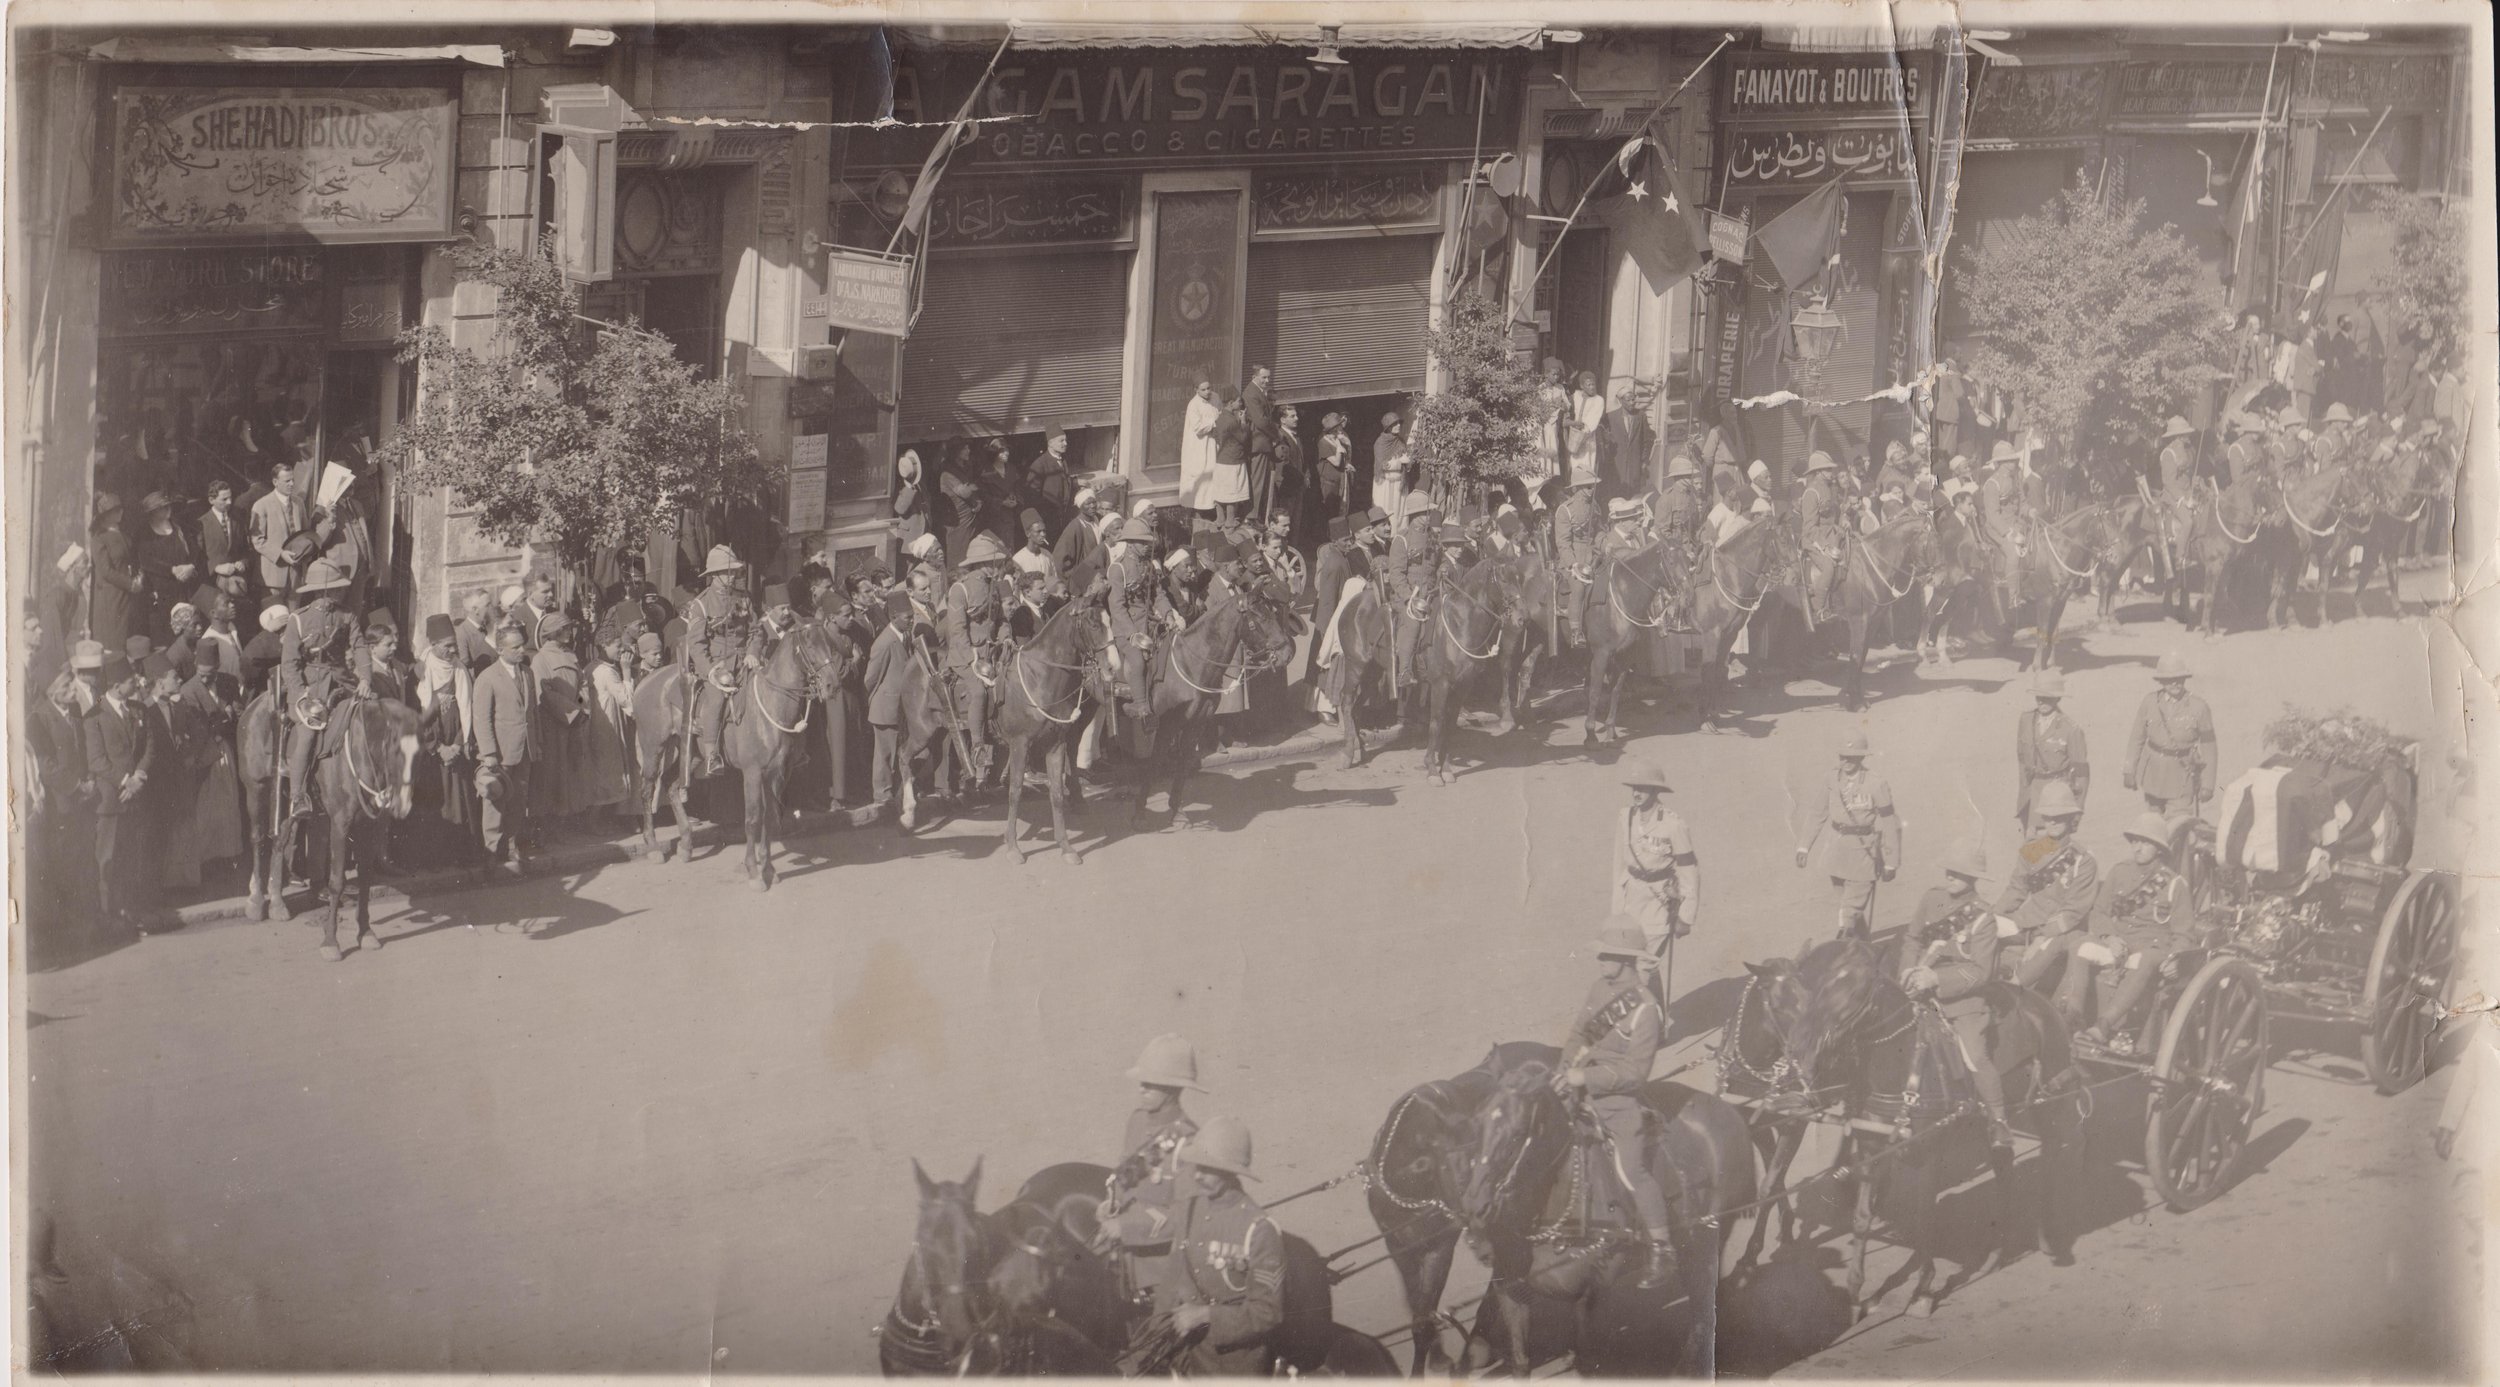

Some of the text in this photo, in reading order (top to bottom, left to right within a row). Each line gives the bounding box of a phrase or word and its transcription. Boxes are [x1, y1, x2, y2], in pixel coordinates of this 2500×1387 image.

[987, 62, 1503, 124] GAMSARAGAN
[1818, 77, 1827, 104] &
[191, 105, 309, 150] SHEHADI
[1166, 130, 1186, 152] &
[1204, 125, 1416, 151] CIGARETTES
[1712, 221, 1744, 243] COGNAC
[239, 254, 314, 285] STORE
[1716, 311, 1740, 399] DRAPERIE
